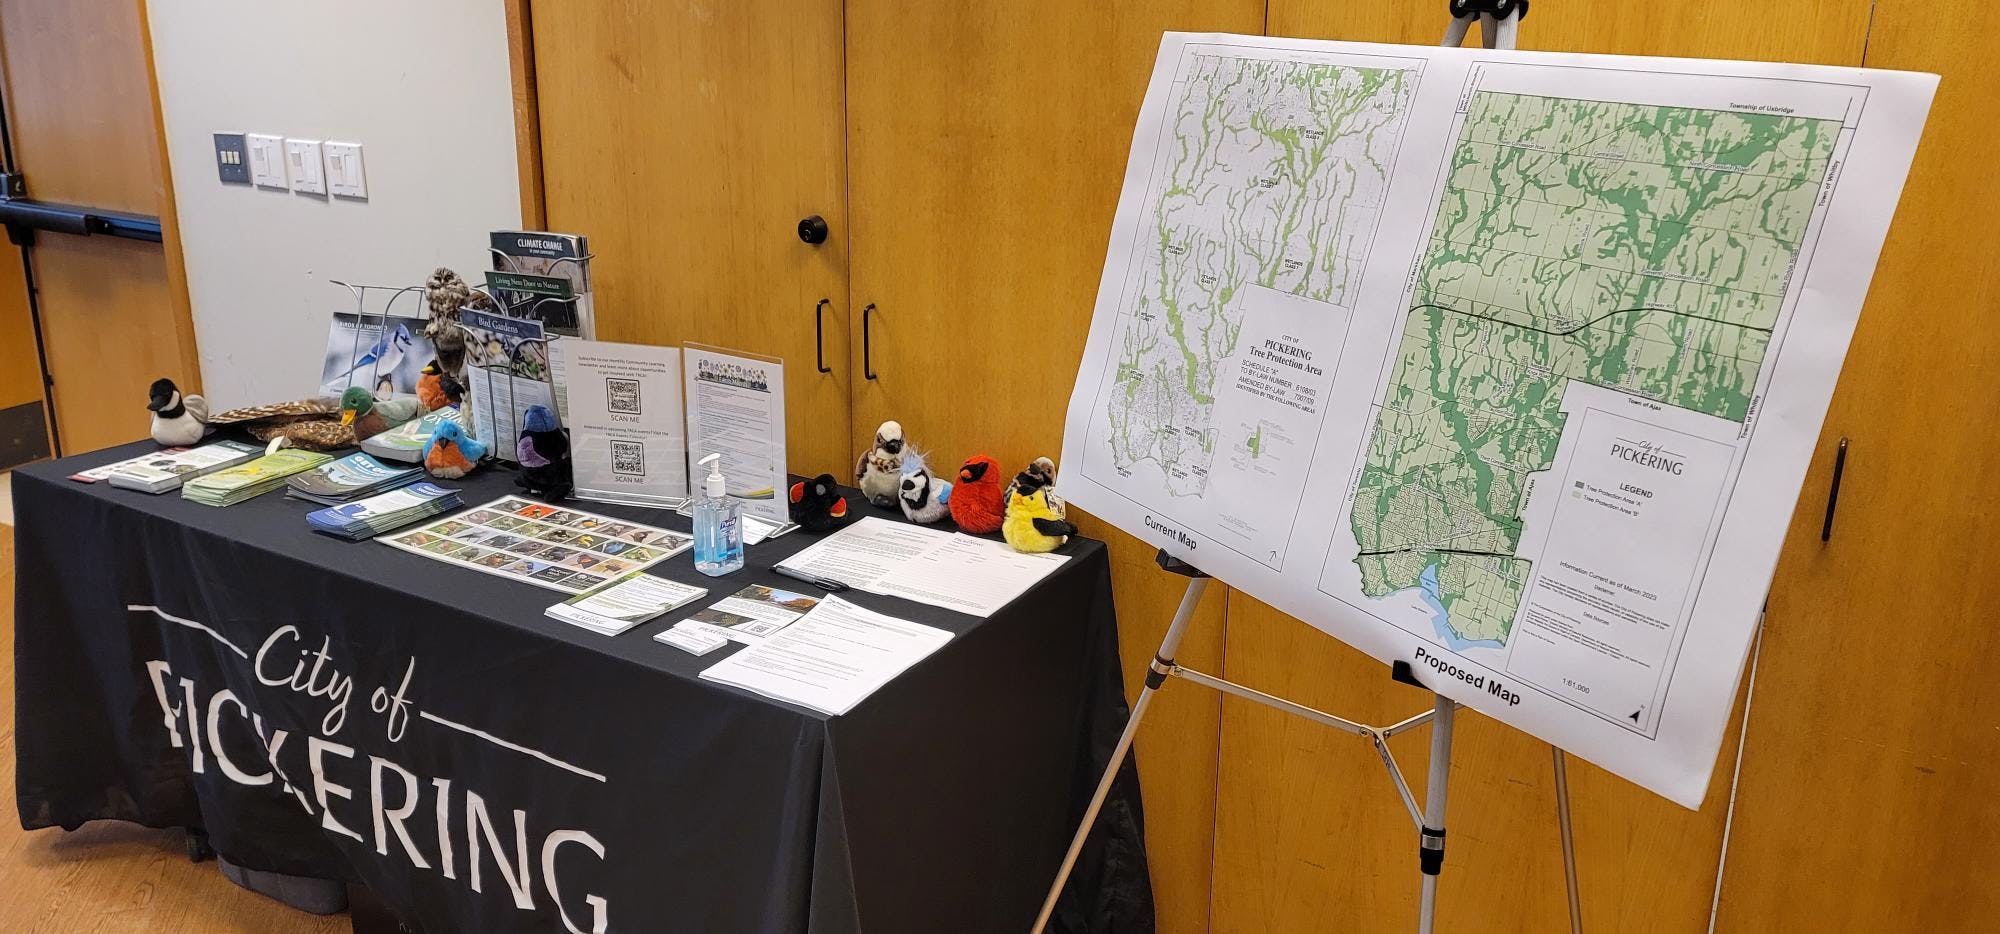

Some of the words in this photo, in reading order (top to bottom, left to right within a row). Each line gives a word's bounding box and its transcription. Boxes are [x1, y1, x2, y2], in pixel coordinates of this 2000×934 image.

[1730, 102, 1757, 111] Township
[1766, 104, 1794, 114] Uxbridge
[1828, 160, 1840, 182] Whitby
[1826, 182, 1831, 190] of
[1818, 191, 1827, 207] Town
[518, 239, 542, 249] CLIMATE
[1412, 254, 1422, 276] Markham
[495, 277, 510, 285] Living
[543, 281, 559, 289] Nature
[478, 317, 490, 327] Bird
[491, 320, 519, 334] Gardens
[1265, 340, 1312, 360] PICKERING
[1242, 360, 1270, 373] SCHEDULE
[1250, 346, 1265, 358] Tree
[1267, 351, 1303, 370] Protection
[1304, 363, 1322, 376] Area
[1239, 376, 1264, 389] AMENDED
[1265, 385, 1286, 396] BY-LAW
[1248, 369, 1268, 380] BY-LAW
[1269, 376, 1292, 388] NUMBER
[1275, 398, 1301, 409] FOLLOWING
[1302, 405, 1315, 414] AREAS
[1628, 398, 1642, 406] Town
[1650, 403, 1661, 411] Ajax
[1749, 395, 1761, 415] Whitby
[1747, 413, 1753, 422] of
[1741, 421, 1750, 439] Town
[1639, 441, 1652, 453] City
[1655, 445, 1663, 454] of
[1611, 444, 1684, 475] PICKERING
[1598, 489, 1622, 500] Protection
[1619, 482, 1653, 498] LEGEND
[1596, 499, 1619, 510] Protection
[1619, 507, 1631, 515] Area
[1144, 515, 1176, 540] Current
[1178, 534, 1197, 550] Map
[1560, 561, 1588, 575] Information
[1589, 572, 1608, 582] Current
[1624, 585, 1641, 595] March
[1642, 591, 1657, 601] 2023
[254, 624, 355, 735] City
[371, 655, 416, 742] of
[1415, 647, 1484, 689] Proposed
[1488, 680, 1520, 706] Map
[145, 660, 609, 934] PICKERING
